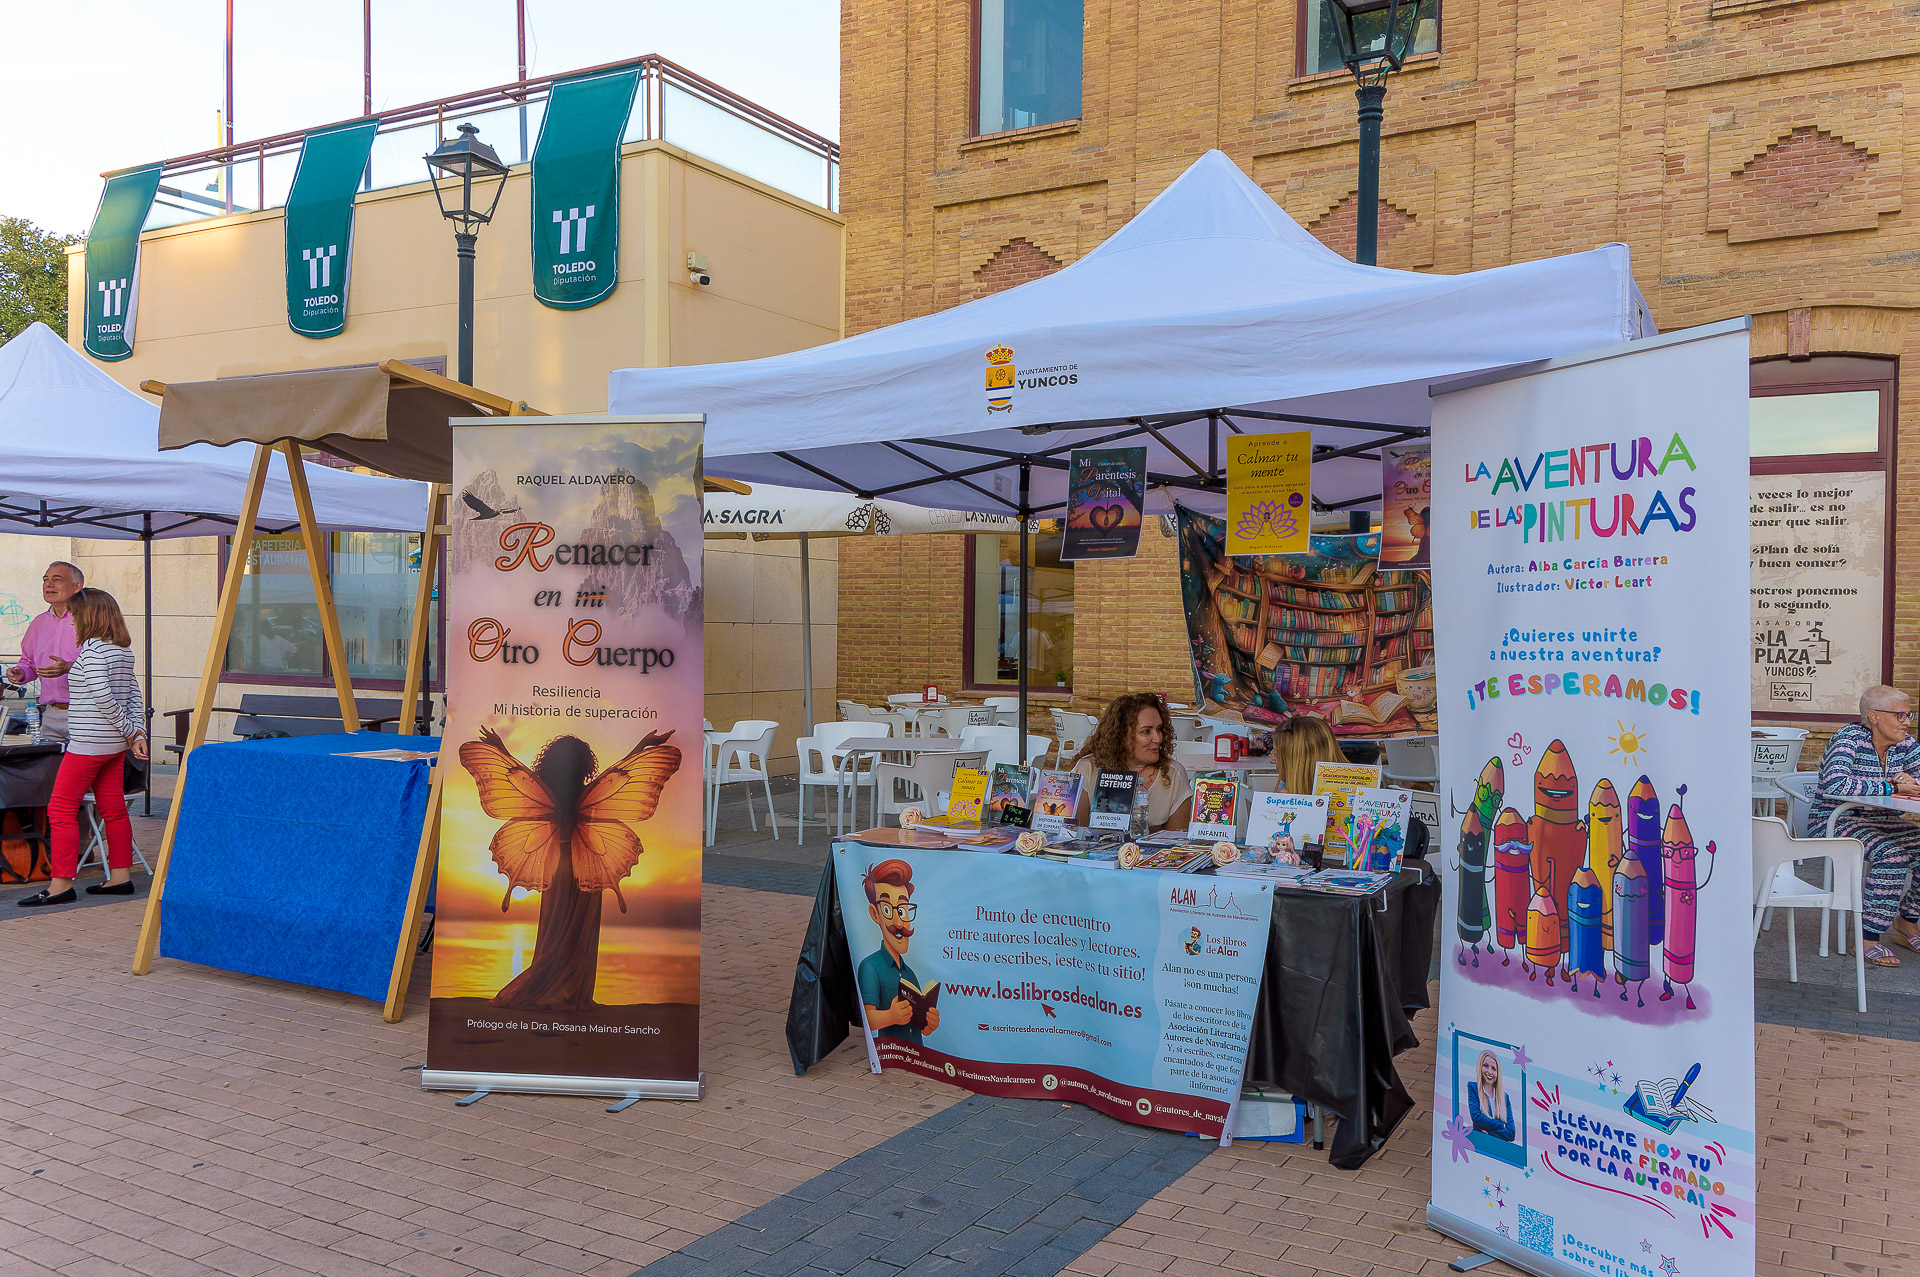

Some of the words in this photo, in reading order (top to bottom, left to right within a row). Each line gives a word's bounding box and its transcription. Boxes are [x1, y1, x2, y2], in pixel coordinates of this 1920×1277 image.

[552, 261, 596, 275] TOLEDO
[553, 274, 596, 285] Diputación
[304, 294, 338, 307] TOLEDO
[303, 307, 339, 317] Diputación
[97, 323, 122, 333] TOLED
[1017, 365, 1067, 376] AYUNTAMIENTO
[1018, 374, 1078, 389] YUNCOS
[1080, 458, 1091, 467] Mi
[1237, 450, 1283, 465] Calmar
[1286, 453, 1298, 462] tu
[1466, 461, 1491, 482] LA
[1491, 432, 1697, 496] AVENTURA
[516, 475, 565, 486] RAQUEL
[568, 475, 636, 486] ALDAVERO
[1080, 467, 1136, 483] Paréntesis
[1251, 468, 1284, 478] mente
[1088, 484, 1121, 501] Vital
[1394, 481, 1418, 495] Otro
[1758, 491, 1793, 500] veces
[1797, 489, 1809, 499] lo
[1813, 488, 1854, 500] mejor
[1470, 509, 1490, 530] DE
[1496, 505, 1523, 527] LAS
[1524, 487, 1696, 543] PINTURAS
[1750, 505, 1764, 513] de
[1810, 504, 1825, 512] es
[1828, 503, 1846, 512] no
[1786, 518, 1811, 528] que
[1815, 517, 1850, 526] salir.
[251, 539, 301, 551] CAFETERIA
[495, 521, 654, 572] Renacer
[1752, 545, 1789, 554] ¿Plan
[1794, 545, 1809, 554] de
[1813, 544, 1840, 554] sofá
[246, 553, 309, 566] ESTAURANTE
[1487, 563, 1525, 575] Autora:
[1529, 560, 1558, 572] Alba
[1563, 557, 1608, 570] García
[1614, 555, 1668, 568] Barrera
[1759, 558, 1791, 568] buen
[1795, 558, 1847, 568] comer?
[1497, 581, 1560, 593] Ilustrador:
[1615, 575, 1652, 588] Leart
[534, 589, 561, 607] en
[576, 585, 606, 607] mi
[1750, 587, 1793, 596] sotros
[1796, 587, 1858, 598] ponemos
[1758, 600, 1770, 609] lo
[1774, 600, 1832, 615] segundo.
[1502, 628, 1575, 647] ¿Quieres
[1582, 628, 1638, 643] unirte
[1767, 630, 1787, 647] LA
[467, 617, 539, 665] Otro
[562, 617, 675, 675] Cuerpo
[1490, 650, 1496, 661] a
[1501, 648, 1564, 662] nuestra
[1571, 647, 1662, 662] aventura?
[1755, 648, 1811, 665] PLAZA
[1764, 666, 1805, 677] YUNCOS
[532, 685, 601, 699] Resiliencia
[1467, 676, 1500, 710] ¡TE
[1508, 672, 1701, 715] ESPERAMOS!
[1773, 690, 1808, 698] SAGRA
[493, 704, 508, 715] Mi
[511, 704, 561, 717] historia
[565, 705, 582, 717] de
[585, 706, 658, 720] superación
[1100, 780, 1132, 789] ESTEMOS
[1101, 773, 1123, 781] CUANDO
[1008, 805, 1023, 815] PACK
[1363, 800, 1402, 809] AVENTURA
[1370, 809, 1401, 818] PINTURAS
[1198, 830, 1228, 838] INFANTIL
[1170, 887, 1197, 906] ALAN
[976, 906, 1016, 924] Punto
[1020, 909, 1038, 924] de
[1042, 913, 1111, 933] encuentro
[948, 928, 979, 942] entre
[982, 931, 1030, 945] autores
[1034, 931, 1077, 948] locales
[1080, 939, 1086, 952] y
[1089, 938, 1141, 959] lectores.
[1206, 935, 1221, 944] Los
[1223, 936, 1247, 947] libros
[1206, 946, 1216, 954] de
[1217, 946, 1239, 957] Alan
[942, 946, 954, 960] Si
[957, 949, 980, 962] lees
[983, 954, 991, 963] o
[994, 951, 1052, 967] escribes,
[1055, 953, 1083, 969] ¡este
[1085, 961, 1096, 973] es
[1098, 962, 1110, 976] tu
[1112, 965, 1146, 981] sitio!
[1162, 963, 1181, 973] Alan
[1184, 967, 1194, 975] no
[1208, 971, 1223, 979] una
[1225, 973, 1257, 986] persona,
[1184, 979, 1201, 989] ¡son
[1204, 982, 1239, 994] muchas!
[944, 980, 1143, 1019] www.loslibrosdealan.es
[1164, 998, 1187, 1009] Pásate
[1194, 1004, 1223, 1014] conocer
[1225, 1008, 1235, 1017] los
[467, 1019, 504, 1030] Prólogo
[506, 1020, 519, 1030] de
[520, 1021, 529, 1030] la
[531, 1021, 550, 1031] Dra.
[552, 1022, 587, 1033] Rosana
[589, 1024, 622, 1034] Mainar
[624, 1025, 661, 1035] Sancho
[1173, 1011, 1181, 1019] de
[1183, 1012, 1193, 1021] los
[1195, 1014, 1230, 1026] escritores
[1231, 1020, 1239, 1028] de
[1241, 1021, 1246, 1030] la
[993, 1024, 1112, 1047] escritoresdenavalcarnero@gmail.com
[1163, 1032, 1193, 1043] Autores
[1194, 1037, 1204, 1045] de
[1168, 1022, 1208, 1035] Asociación
[1210, 1027, 1240, 1041] Literaria
[1167, 1044, 1174, 1052] Y,
[1184, 1047, 1215, 1059] escribes,
[1164, 1056, 1204, 1067] encantados
[1205, 1061, 1215, 1069] de
[1216, 1064, 1229, 1072] que
[957, 1068, 1036, 1084] @EscritoresNavalcarnero
[1170, 1068, 1189, 1077] parte
[1201, 1071, 1208, 1079] la
[1059, 1078, 1132, 1107] @autores_de_navalcarnero
[1189, 1080, 1228, 1095] ¡Infórmate!
[1154, 1104, 1226, 1124] @autores_de_navalc
[1552, 1109, 1637, 1148] ¡LLÉVATE
[1644, 1137, 1681, 1160] HOY
[1687, 1153, 1711, 1172] TU
[1541, 1121, 1633, 1164] EJEMPLAR
[1639, 1154, 1725, 1196] FIRMADO
[1558, 1145, 1591, 1168] POR
[1597, 1157, 1618, 1177] LA
[1623, 1167, 1705, 1209] AUTORA!
[1562, 1233, 1625, 1266] ¡Descubre
[1630, 1262, 1654, 1277] más
[1562, 1248, 1595, 1268] sobre
[1599, 1264, 1611, 1275] el
